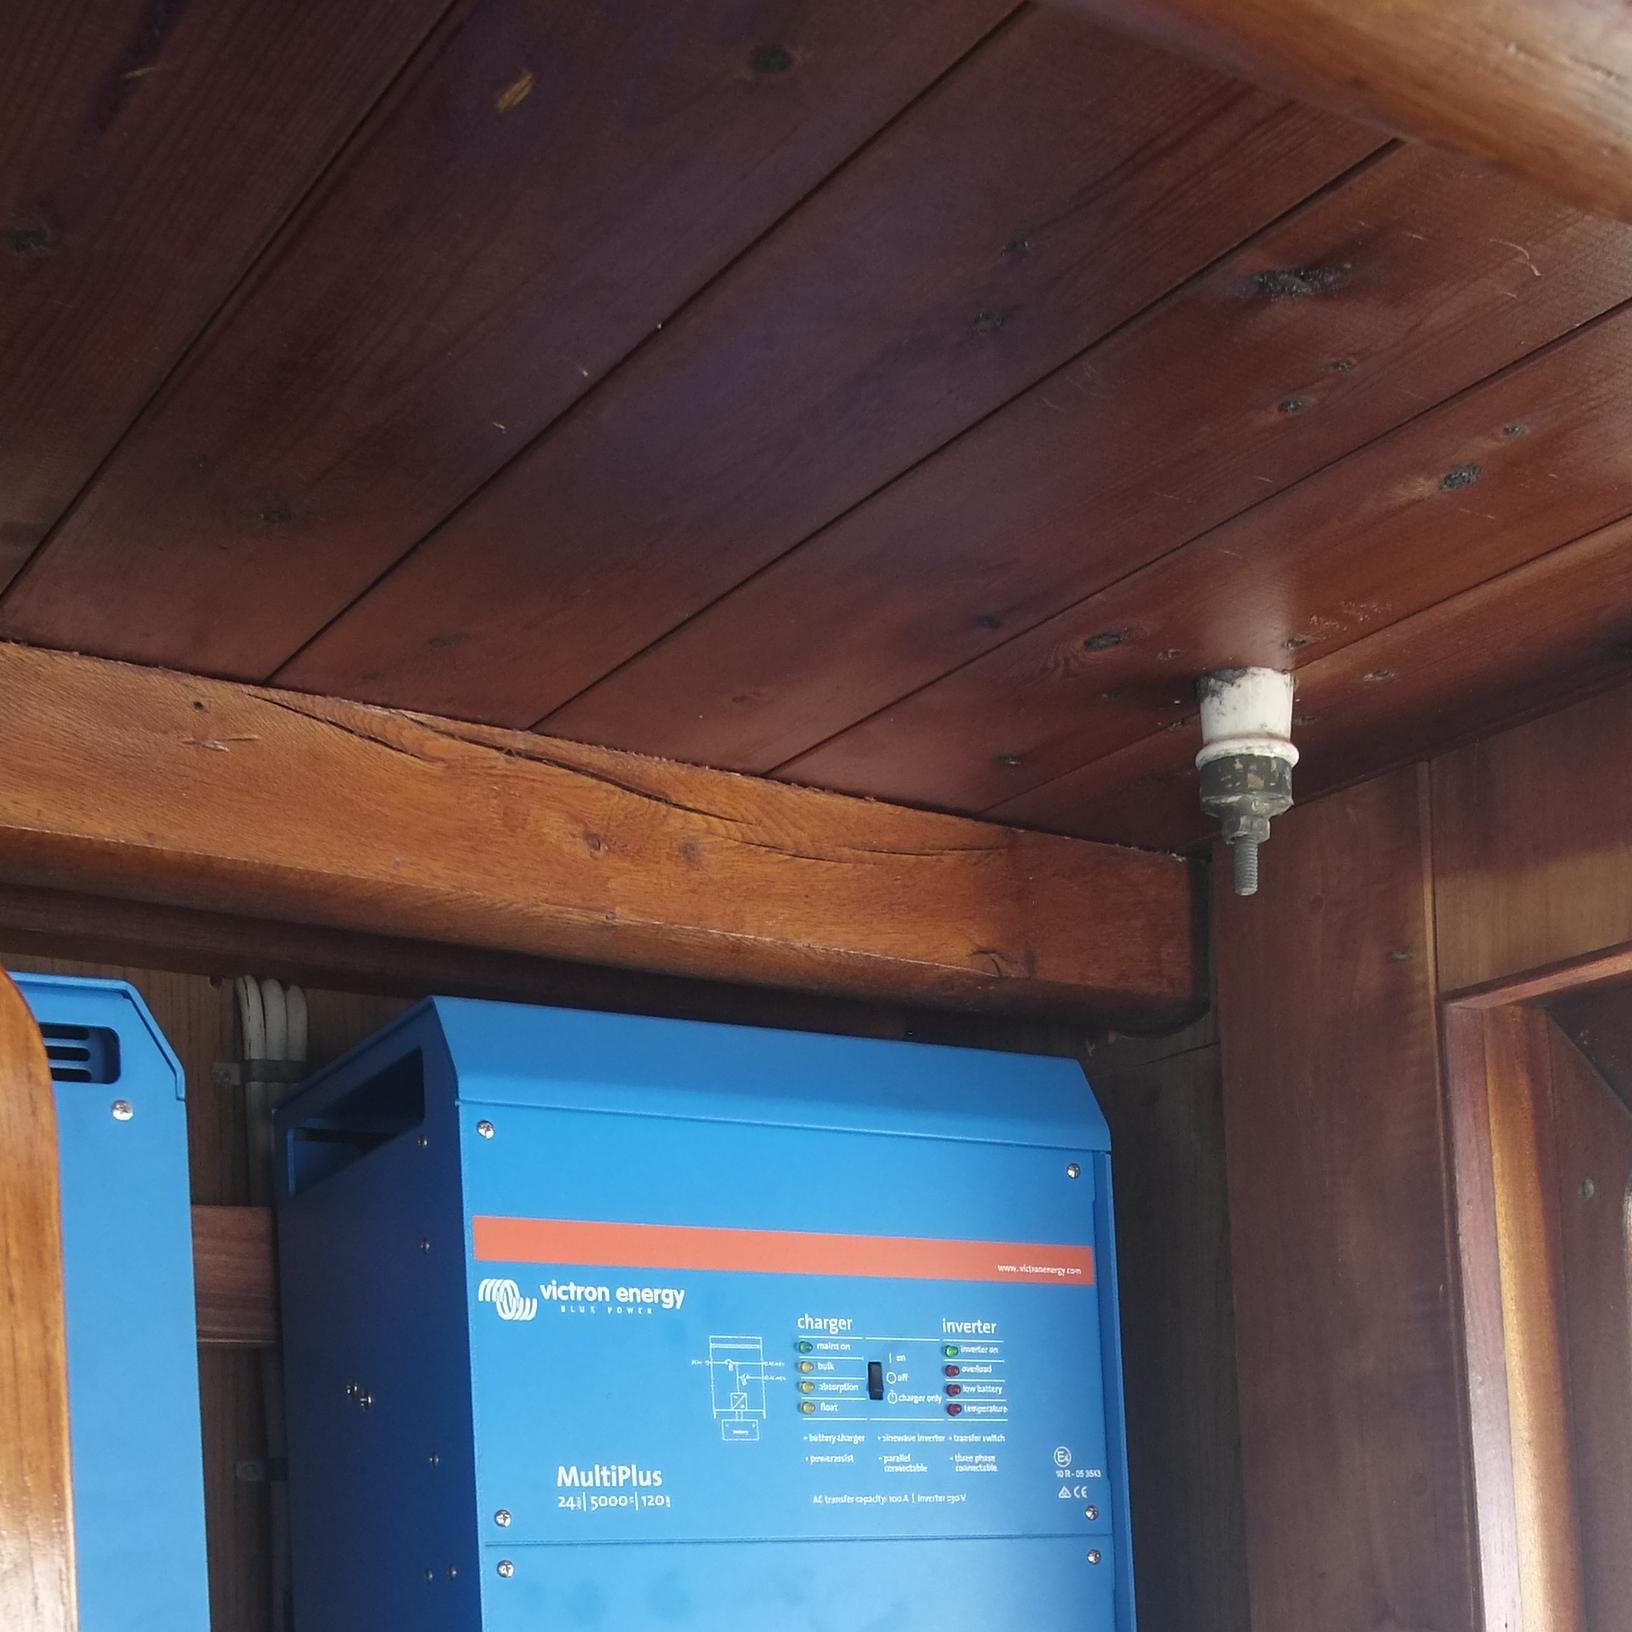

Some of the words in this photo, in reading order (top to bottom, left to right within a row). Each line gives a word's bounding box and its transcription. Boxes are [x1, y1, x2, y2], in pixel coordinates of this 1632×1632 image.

[540, 1279, 610, 1302] victron
[615, 1285, 685, 1309] energy
[560, 1305, 596, 1314] BLUE
[607, 1306, 653, 1315] POWER
[797, 1314, 853, 1334] charger
[943, 1318, 997, 1334] inverter
[840, 1343, 851, 1351] on
[896, 1354, 906, 1362] on
[817, 1361, 835, 1370] bulk
[961, 1364, 992, 1374] overload
[897, 1372, 909, 1382] off
[819, 1382, 859, 1393] absorption
[962, 1385, 976, 1393] low
[977, 1384, 1003, 1395] battery
[898, 1393, 926, 1404] charger
[820, 1401, 839, 1411] float
[963, 1403, 1009, 1413] temperature
[557, 1464, 663, 1488] MultiPlus
